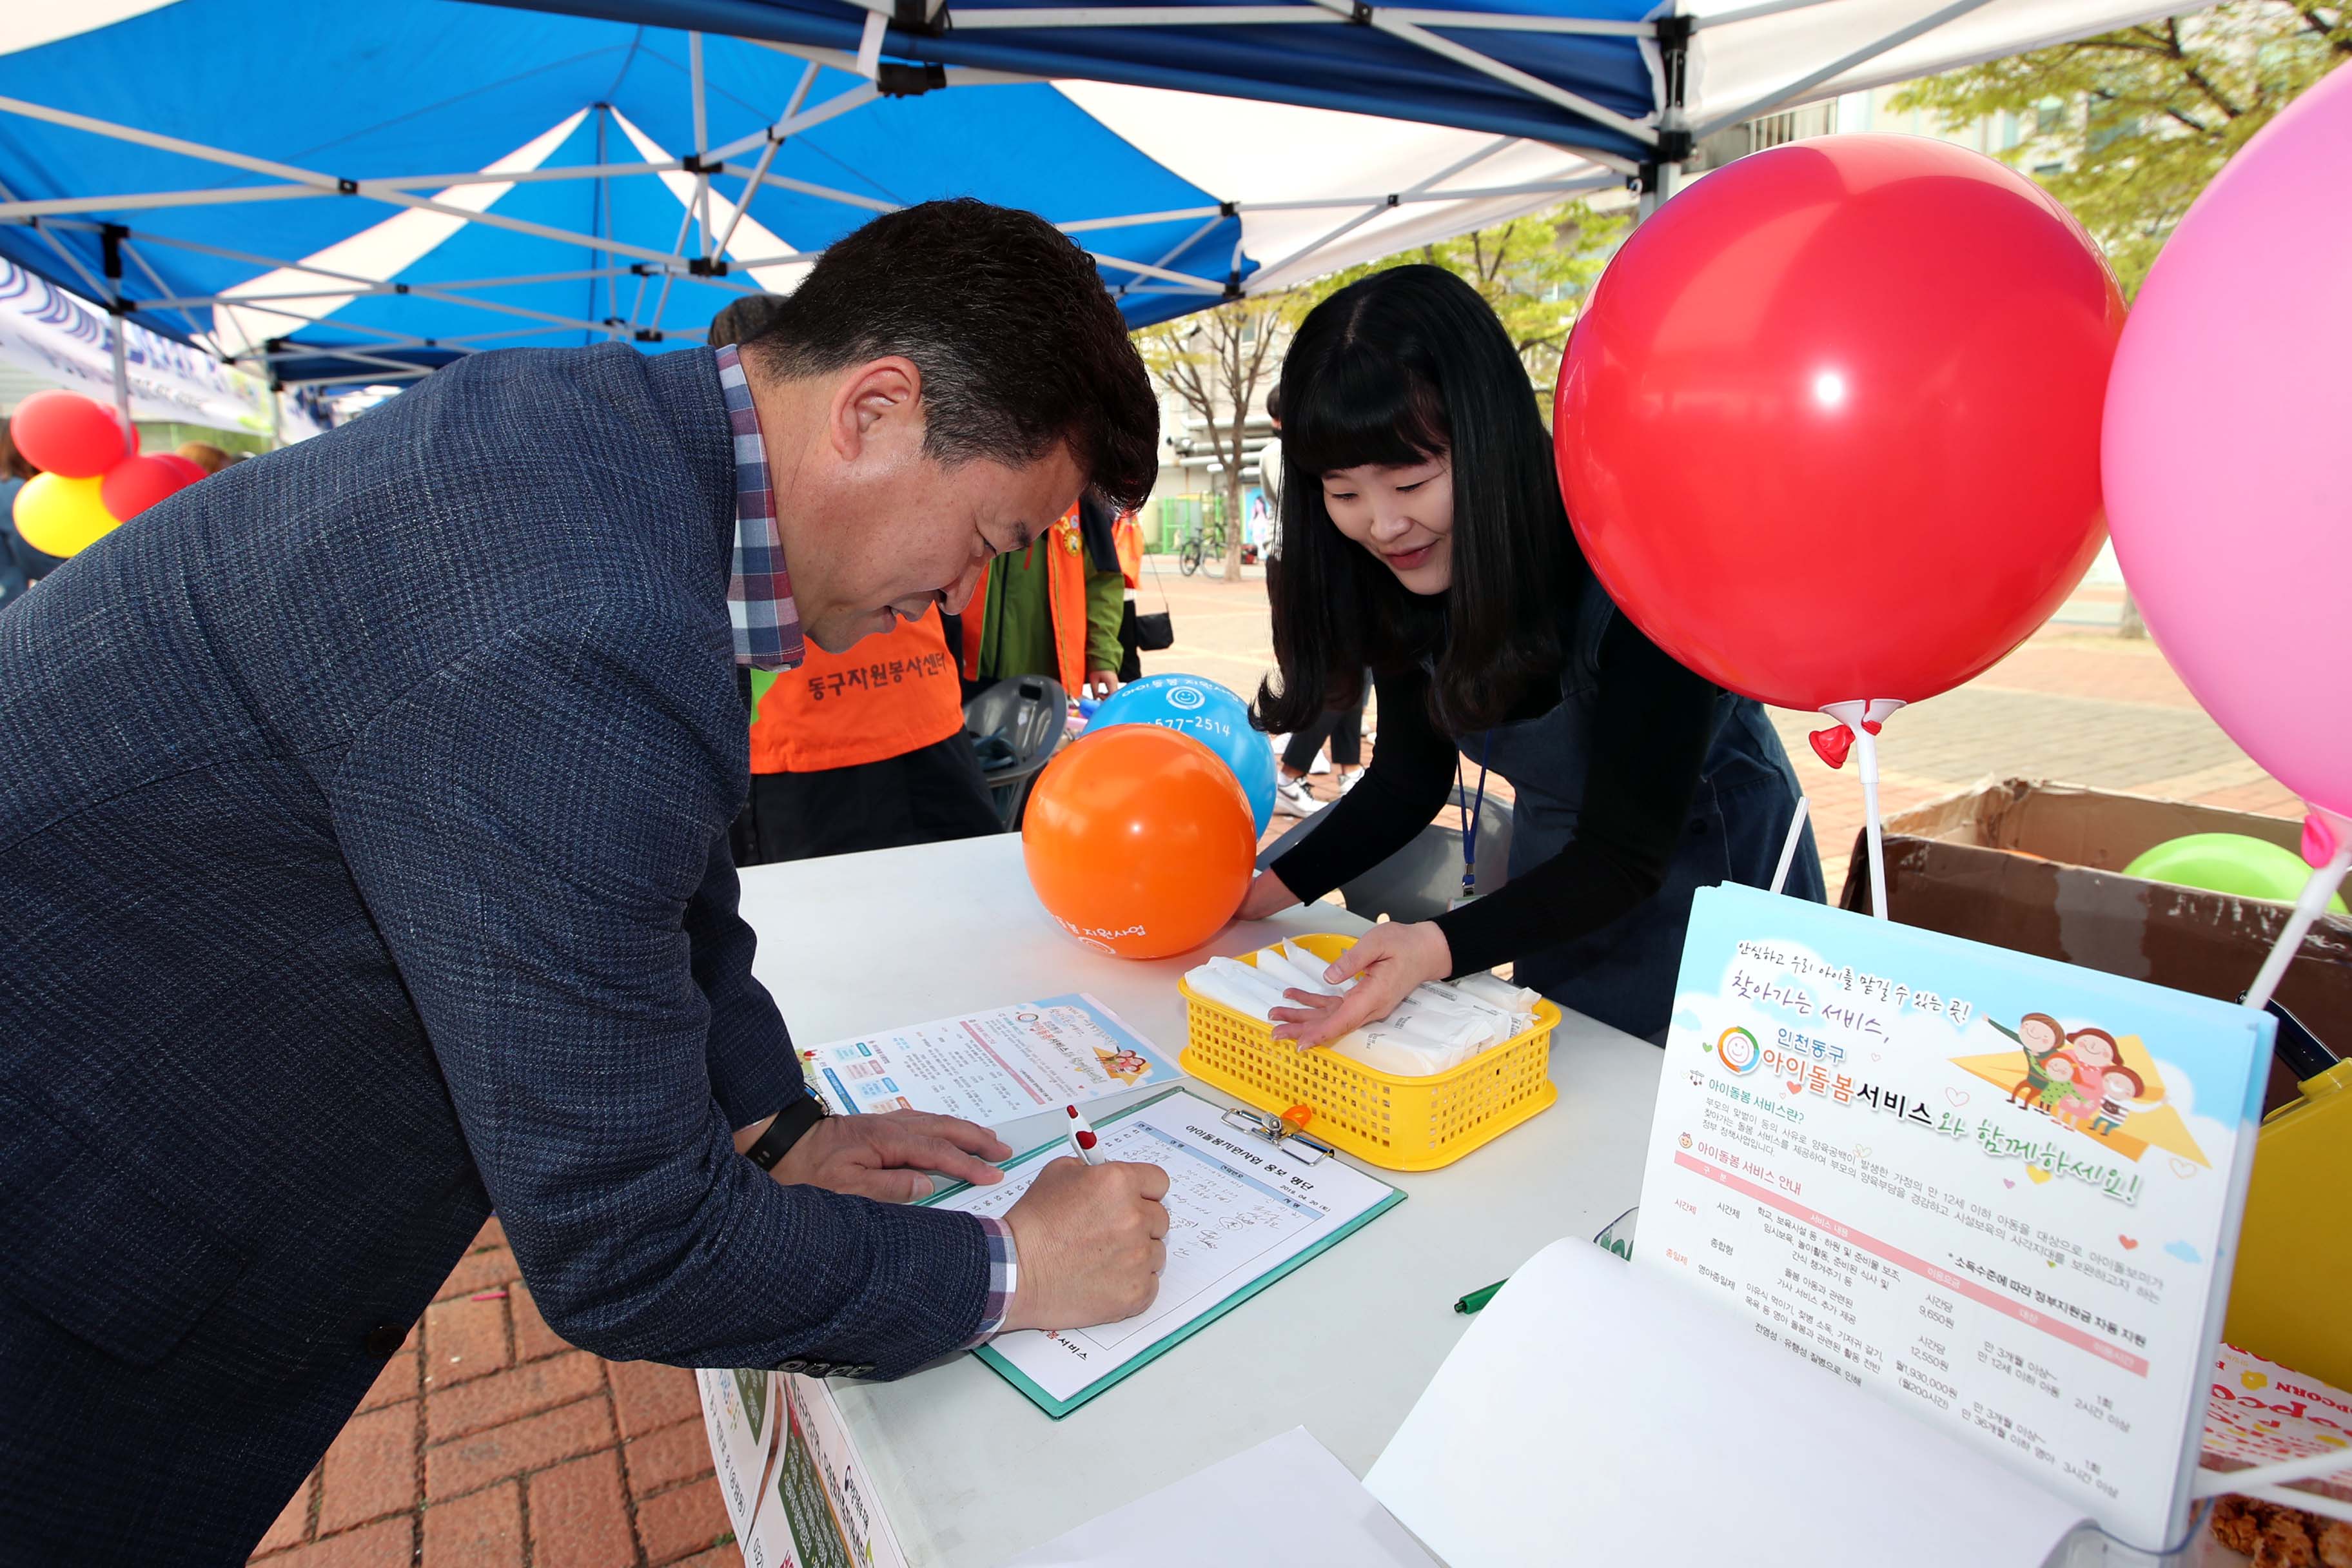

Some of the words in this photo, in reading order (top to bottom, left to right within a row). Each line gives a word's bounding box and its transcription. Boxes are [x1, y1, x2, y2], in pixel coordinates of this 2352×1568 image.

[808, 652, 947, 700] 동구자원봉사센터
[1122, 678, 1179, 697] 아이돌봄
[1149, 716, 1231, 737] 577-2514
[1083, 925, 1146, 939] 지원사업
[1738, 942, 1785, 966] 안심하고
[1790, 955, 1814, 974] 우리
[1818, 966, 1853, 992] 아이를
[1859, 975, 1890, 1003] 맡길
[1895, 986, 1910, 1006] 수
[1914, 993, 1946, 1015] 있는
[1949, 1001, 1969, 1023] 곳!
[1731, 969, 1812, 1014] 찾아가는
[1821, 1004, 1890, 1044] 서비스,
[1777, 1028, 1845, 1063] 인천동구
[1709, 1078, 1751, 1104] 아이돌봄
[1753, 1095, 1805, 1125] 서비스란?
[1702, 1119, 1718, 1132] 정부
[1720, 1126, 1775, 1157] 정책사업입니다.
[1185, 1125, 1264, 1166] 아이돌봄지원사업
[1263, 1164, 1288, 1177] 홍보
[1289, 1176, 1315, 1191] 명단
[1698, 1141, 1740, 1169] 아이돌봄
[1741, 1161, 1775, 1184] 서비스
[1778, 1175, 1802, 1196] 안내
[1977, 1119, 2141, 1203] 함께하세요!
[1705, 1097, 1730, 1114] 부모의
[1733, 1107, 1758, 1125] 맞벌이
[1761, 1119, 1779, 1134] 등의
[1781, 1128, 1807, 1146] 사유로
[1811, 1139, 1857, 1166] 양육공백이
[1861, 1159, 1889, 1179] 발생한
[1893, 1172, 1923, 1193] 가정의
[1928, 1186, 1939, 1199] 만
[1944, 1193, 1966, 1210] 12세
[1970, 1204, 1992, 1220] 이하
[1997, 1214, 2031, 1236] 아동을
[2036, 1230, 2083, 1258] 대상으로
[1674, 1198, 1698, 1215] 시간제
[1703, 1108, 1734, 1128] 찾아가는
[1737, 1121, 1754, 1136] 돌봄
[1756, 1130, 1790, 1151] 서비스를
[1792, 1144, 1827, 1166] 제공하여
[1830, 1159, 1857, 1179] 부모의
[1860, 1171, 1906, 1199] 양육부담을
[1911, 1193, 1949, 1217] 경감하고
[1954, 1211, 2006, 1240] 시설보육의
[2010, 1235, 2065, 1266] 사각지대를
[2071, 1259, 2130, 1291] 보완하고자
[1716, 1201, 1741, 1220] 시간제
[1810, 1214, 1832, 1230] 서비스
[1833, 1224, 1848, 1237] 내용
[1665, 1248, 1689, 1266] 종일제
[1710, 1237, 1734, 1257] 종합형
[1757, 1206, 1774, 1222] 학교,
[1776, 1215, 1807, 1237] 보육시설
[1843, 1246, 1852, 1259] 및
[1854, 1251, 1879, 1271] 준비물
[1881, 1265, 1901, 1283] 보조,
[1763, 1222, 1794, 1247] 임시보육,
[1798, 1239, 1830, 1263] 놀이활동,
[1833, 1255, 1858, 1276] 준비된
[1860, 1269, 1878, 1285] 식사
[1880, 1279, 1890, 1291] 및
[1698, 1264, 1736, 1291] 영아종일제
[1792, 1250, 1808, 1266] 간식
[1810, 1259, 1842, 1282] 챙겨주기
[1927, 1267, 1961, 1289] 이용요금
[1776, 1278, 1793, 1293] 가사
[1794, 1287, 1818, 1305] 서비스
[1820, 1300, 1838, 1316] 추가
[1839, 1309, 1857, 1326] 제공
[1785, 1267, 1800, 1283] 돌봄
[1802, 1277, 1827, 1295] 아동과
[1828, 1289, 1854, 1309] 관련된
[1925, 1294, 1954, 1314] 시간당
[1954, 1257, 2008, 1288] 소득수준에
[2009, 1279, 2032, 1298] 따라
[2035, 1289, 2092, 1324] 정부지원금
[2095, 1316, 2119, 1336] 자동
[2122, 1328, 2146, 1348] 지원
[1745, 1295, 1760, 1310] 목욕
[1790, 1319, 1814, 1339] 돌봄과
[1816, 1333, 1841, 1354] 관련된
[1843, 1348, 1861, 1364] 활동
[1863, 1358, 1881, 1375] 전반
[1746, 1282, 1769, 1301] 이유식
[1770, 1295, 1795, 1316] 먹이기,
[1798, 1309, 1814, 1325] 젖병
[1815, 1320, 1834, 1337] 소독,
[1837, 1330, 1863, 1350] 기저귀
[1865, 1344, 1883, 1363] 갈기,
[1918, 1304, 1955, 1330] 9,650원
[1044, 1329, 1088, 1361] 봄서비스
[1910, 1346, 1950, 1373] 12,550원
[1917, 1335, 1946, 1356] 시간당
[1984, 1340, 1995, 1353] 만
[1997, 1347, 2024, 1368] 3개월
[1810, 1351, 1842, 1377] 질병으로
[1845, 1370, 1862, 1387] 인해
[1896, 1359, 1958, 1400] 월1,930,000원
[1977, 1350, 1988, 1364] 만
[1991, 1358, 2012, 1376] 12세
[2015, 1369, 2036, 1387] 이하
[2039, 1381, 2061, 1399] 아동
[1898, 1377, 1949, 1410] (월200시간)
[1961, 1408, 1972, 1421] 만
[1974, 1415, 2006, 1440] 36개월
[2010, 1435, 2031, 1452] 이하
[1973, 1401, 1984, 1415] 만
[1986, 1408, 2014, 1430] 3개월
[2073, 1397, 2104, 1420] 2시간
[2107, 1414, 2131, 1433] 이상
[2063, 1461, 2092, 1485] 3시간
[2095, 1479, 2119, 1500] 이상
